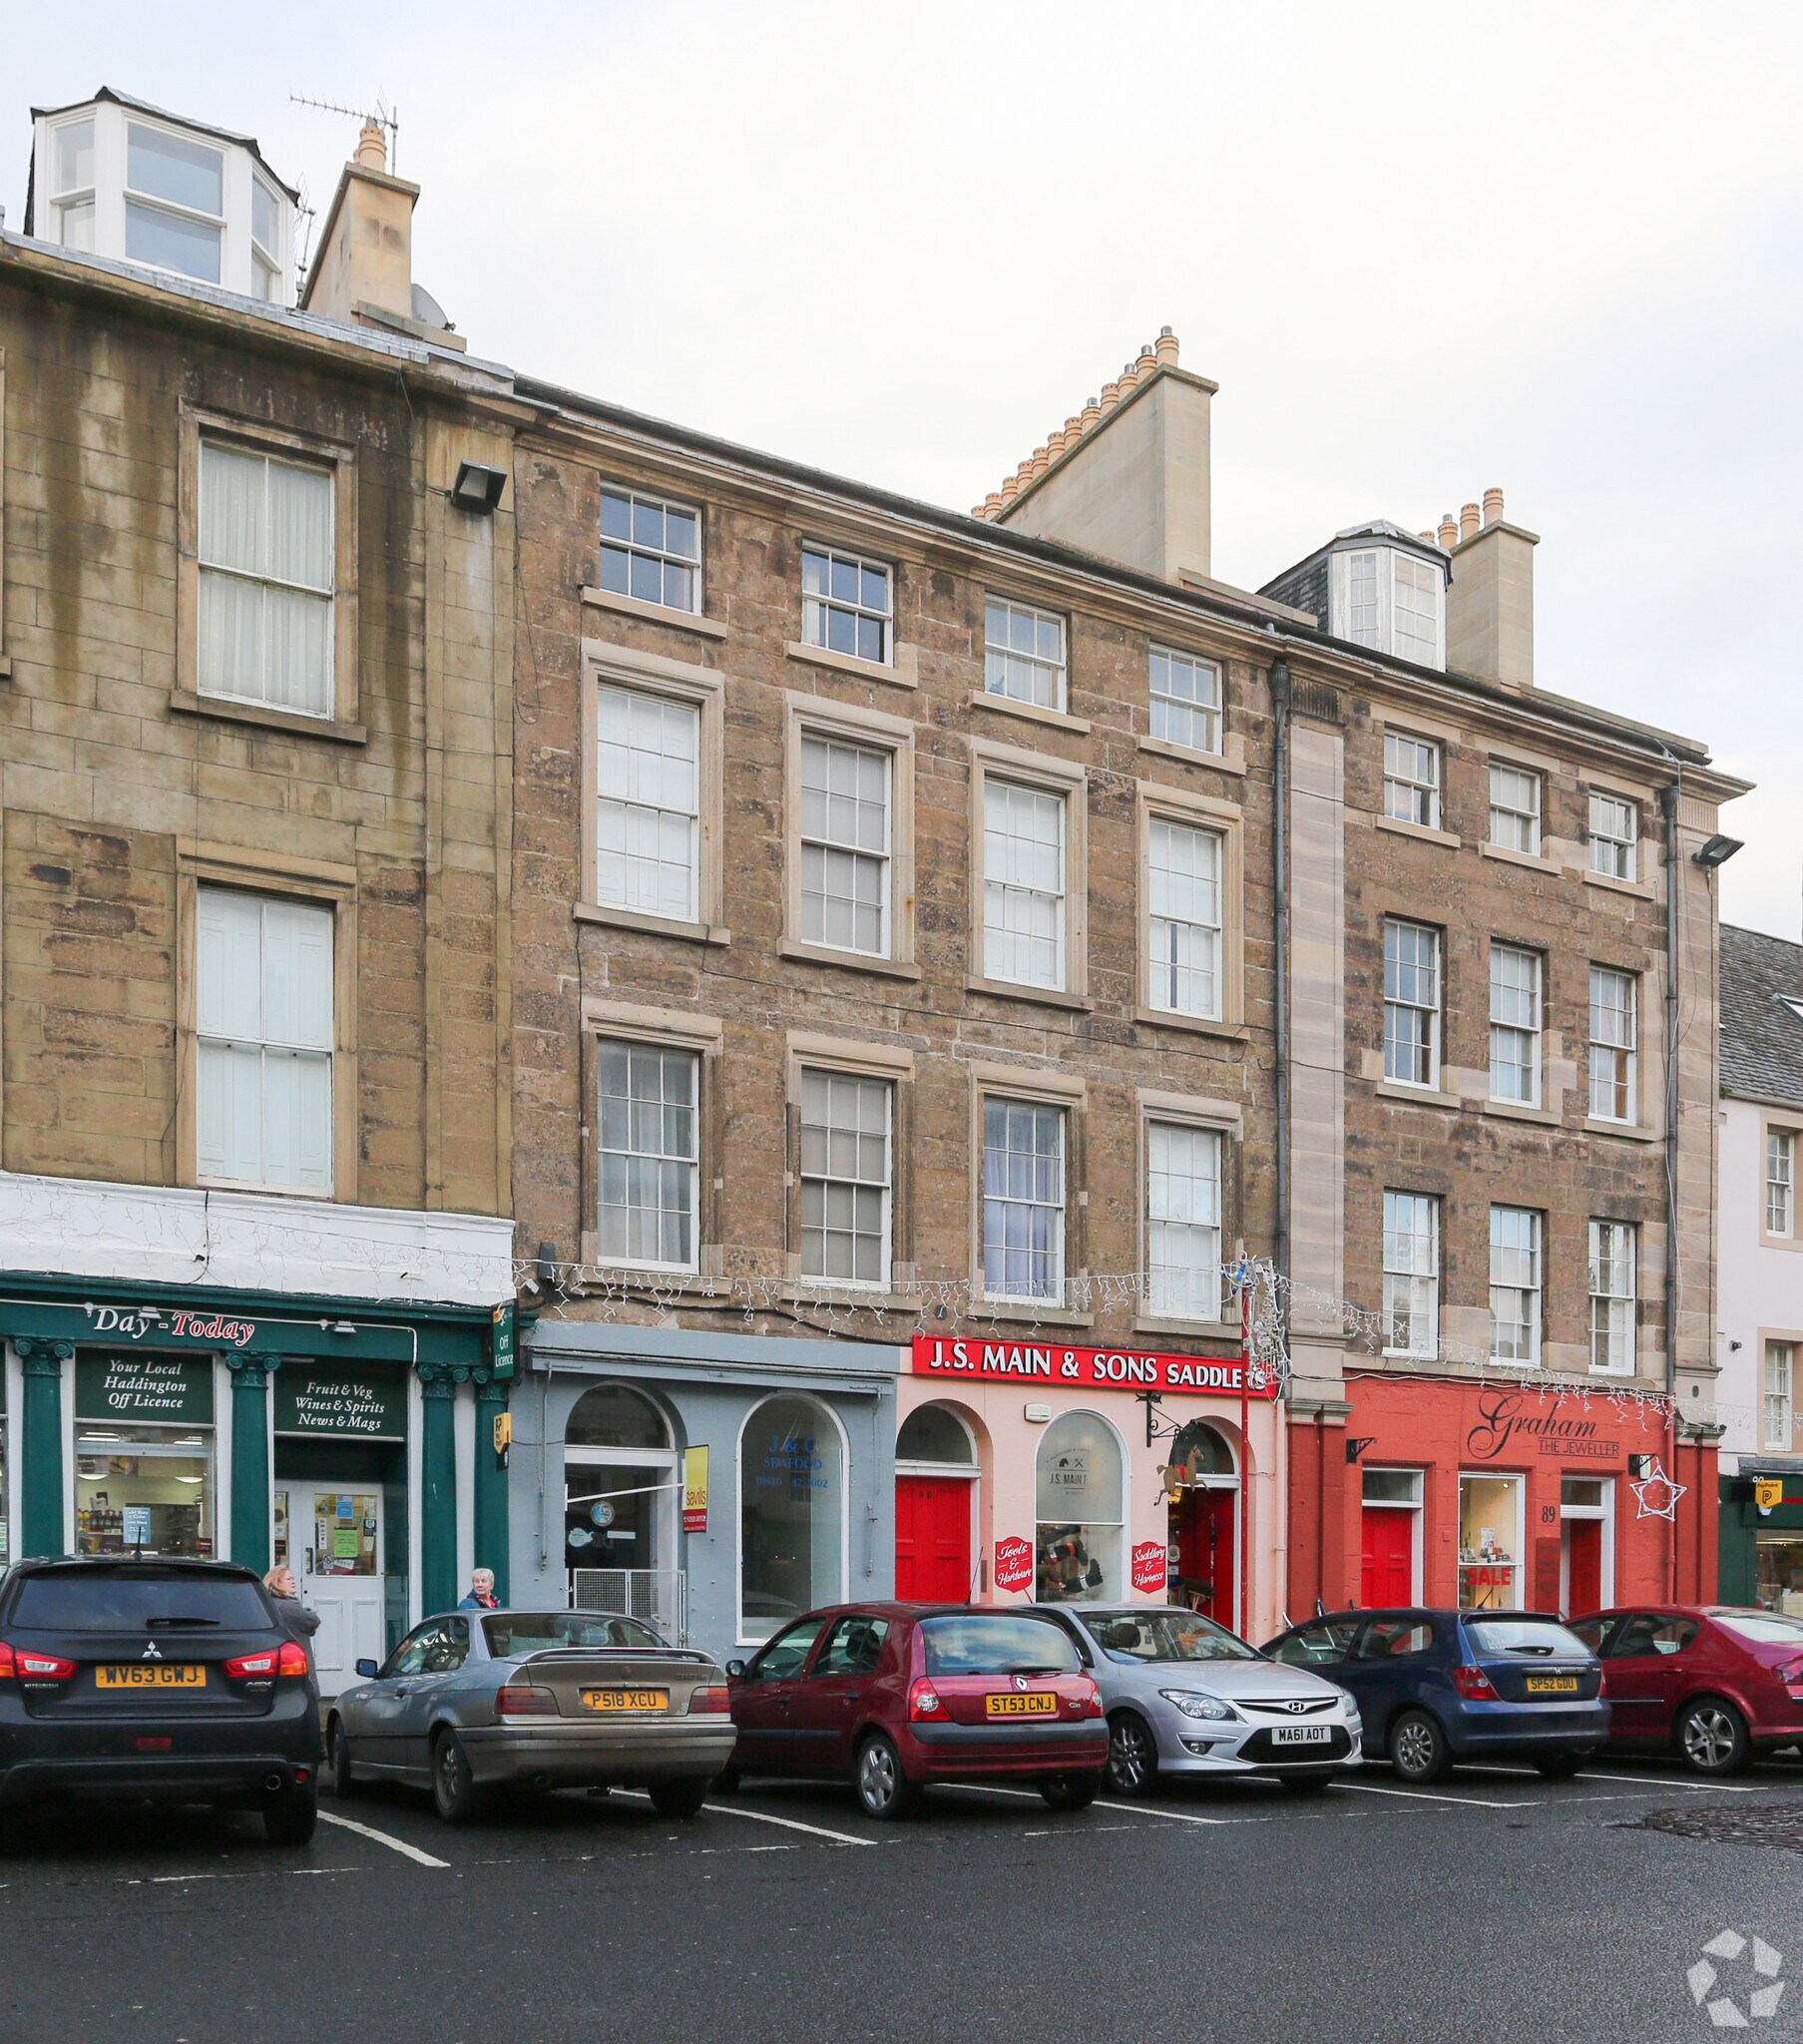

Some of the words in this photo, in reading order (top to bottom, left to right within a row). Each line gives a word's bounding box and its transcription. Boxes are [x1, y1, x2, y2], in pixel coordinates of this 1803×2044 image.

[94, 1307, 150, 1339] Day
[499, 1334, 509, 1350] Off
[109, 1359, 140, 1373] Your
[145, 1361, 182, 1375] Local
[495, 1353, 514, 1368] Licence
[930, 1341, 975, 1369] J.S.
[983, 1345, 1051, 1375] MAIN
[1061, 1351, 1080, 1377] &
[1094, 1354, 1157, 1382] SONS
[1167, 1363, 1266, 1390] SADDLES
[104, 1376, 187, 1393] Haddington
[305, 1382, 339, 1395] Fruit
[340, 1384, 351, 1395] &
[353, 1385, 373, 1400] Veg
[108, 1393, 132, 1409] Off
[134, 1395, 184, 1408] Licence
[295, 1397, 331, 1410] Wines
[333, 1399, 343, 1411] &
[344, 1400, 385, 1414] Spirits
[297, 1413, 334, 1426] News
[336, 1416, 346, 1427] &
[346, 1416, 381, 1431] Mags
[1468, 1389, 1597, 1460] Graham
[1539, 1440, 1559, 1453] THE
[1562, 1442, 1620, 1456] JEWELLER
[763, 1456, 822, 1469] SEAFOOD
[686, 1487, 706, 1505] savills
[1542, 1505, 1556, 1523] 89
[997, 1543, 1028, 1560] Tools
[1133, 1547, 1165, 1564] Saddlery
[1009, 1557, 1020, 1570] &
[1144, 1561, 1154, 1572] &
[998, 1568, 1032, 1585] Hardware
[1134, 1572, 1164, 1586] Harness
[1468, 1567, 1511, 1586] SALE
[106, 1667, 156, 1684] WV63
[161, 1666, 199, 1683] GWJ
[1532, 1679, 1555, 1690] SP52
[1558, 1679, 1574, 1689] GDU
[592, 1693, 625, 1708] P518
[630, 1693, 657, 1707] XCU
[992, 1698, 1025, 1712] ST53
[1029, 1697, 1052, 1711] CNJ
[1278, 1729, 1303, 1742] MA61
[1306, 1728, 1325, 1741] AOT
